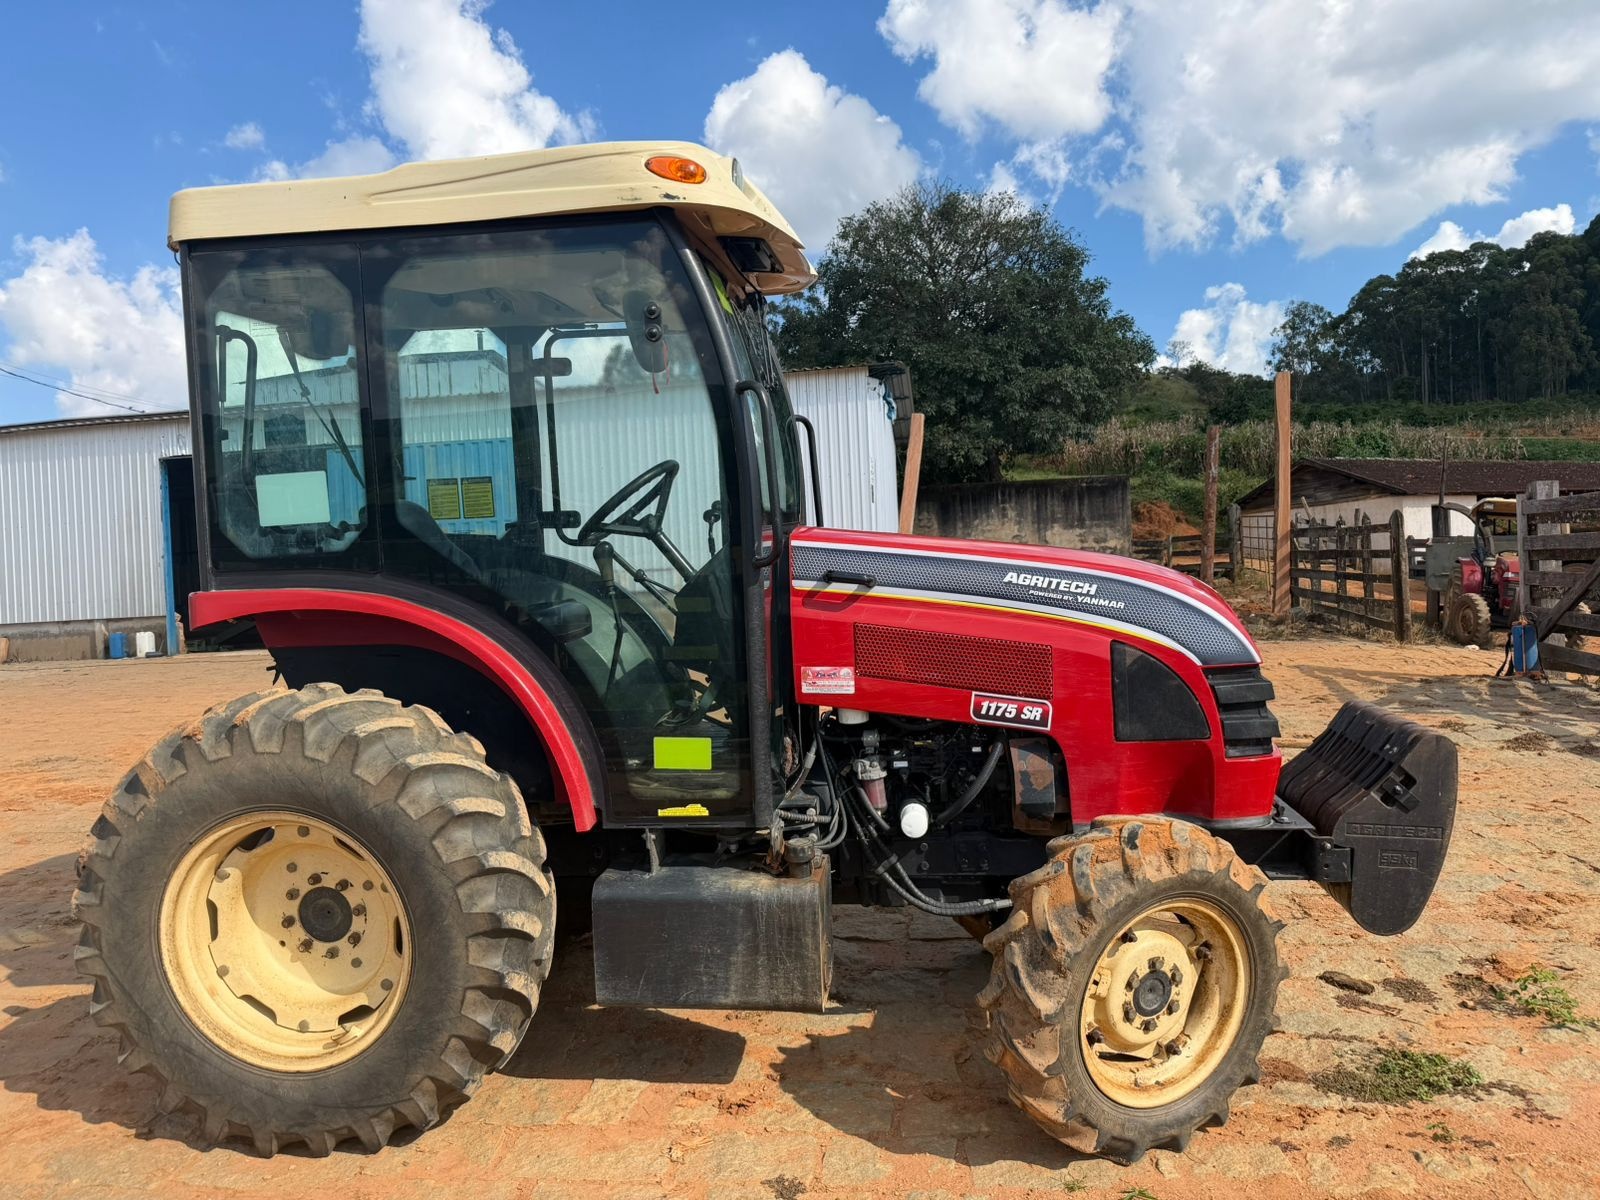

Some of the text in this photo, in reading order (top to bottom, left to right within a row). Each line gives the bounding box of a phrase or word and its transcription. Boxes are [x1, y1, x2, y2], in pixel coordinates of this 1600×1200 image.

[1003, 572, 1098, 595] AGRITECH
[1028, 589, 1126, 609] POWERED BY YANMAR
[981, 701, 1043, 721] 1175 SR
